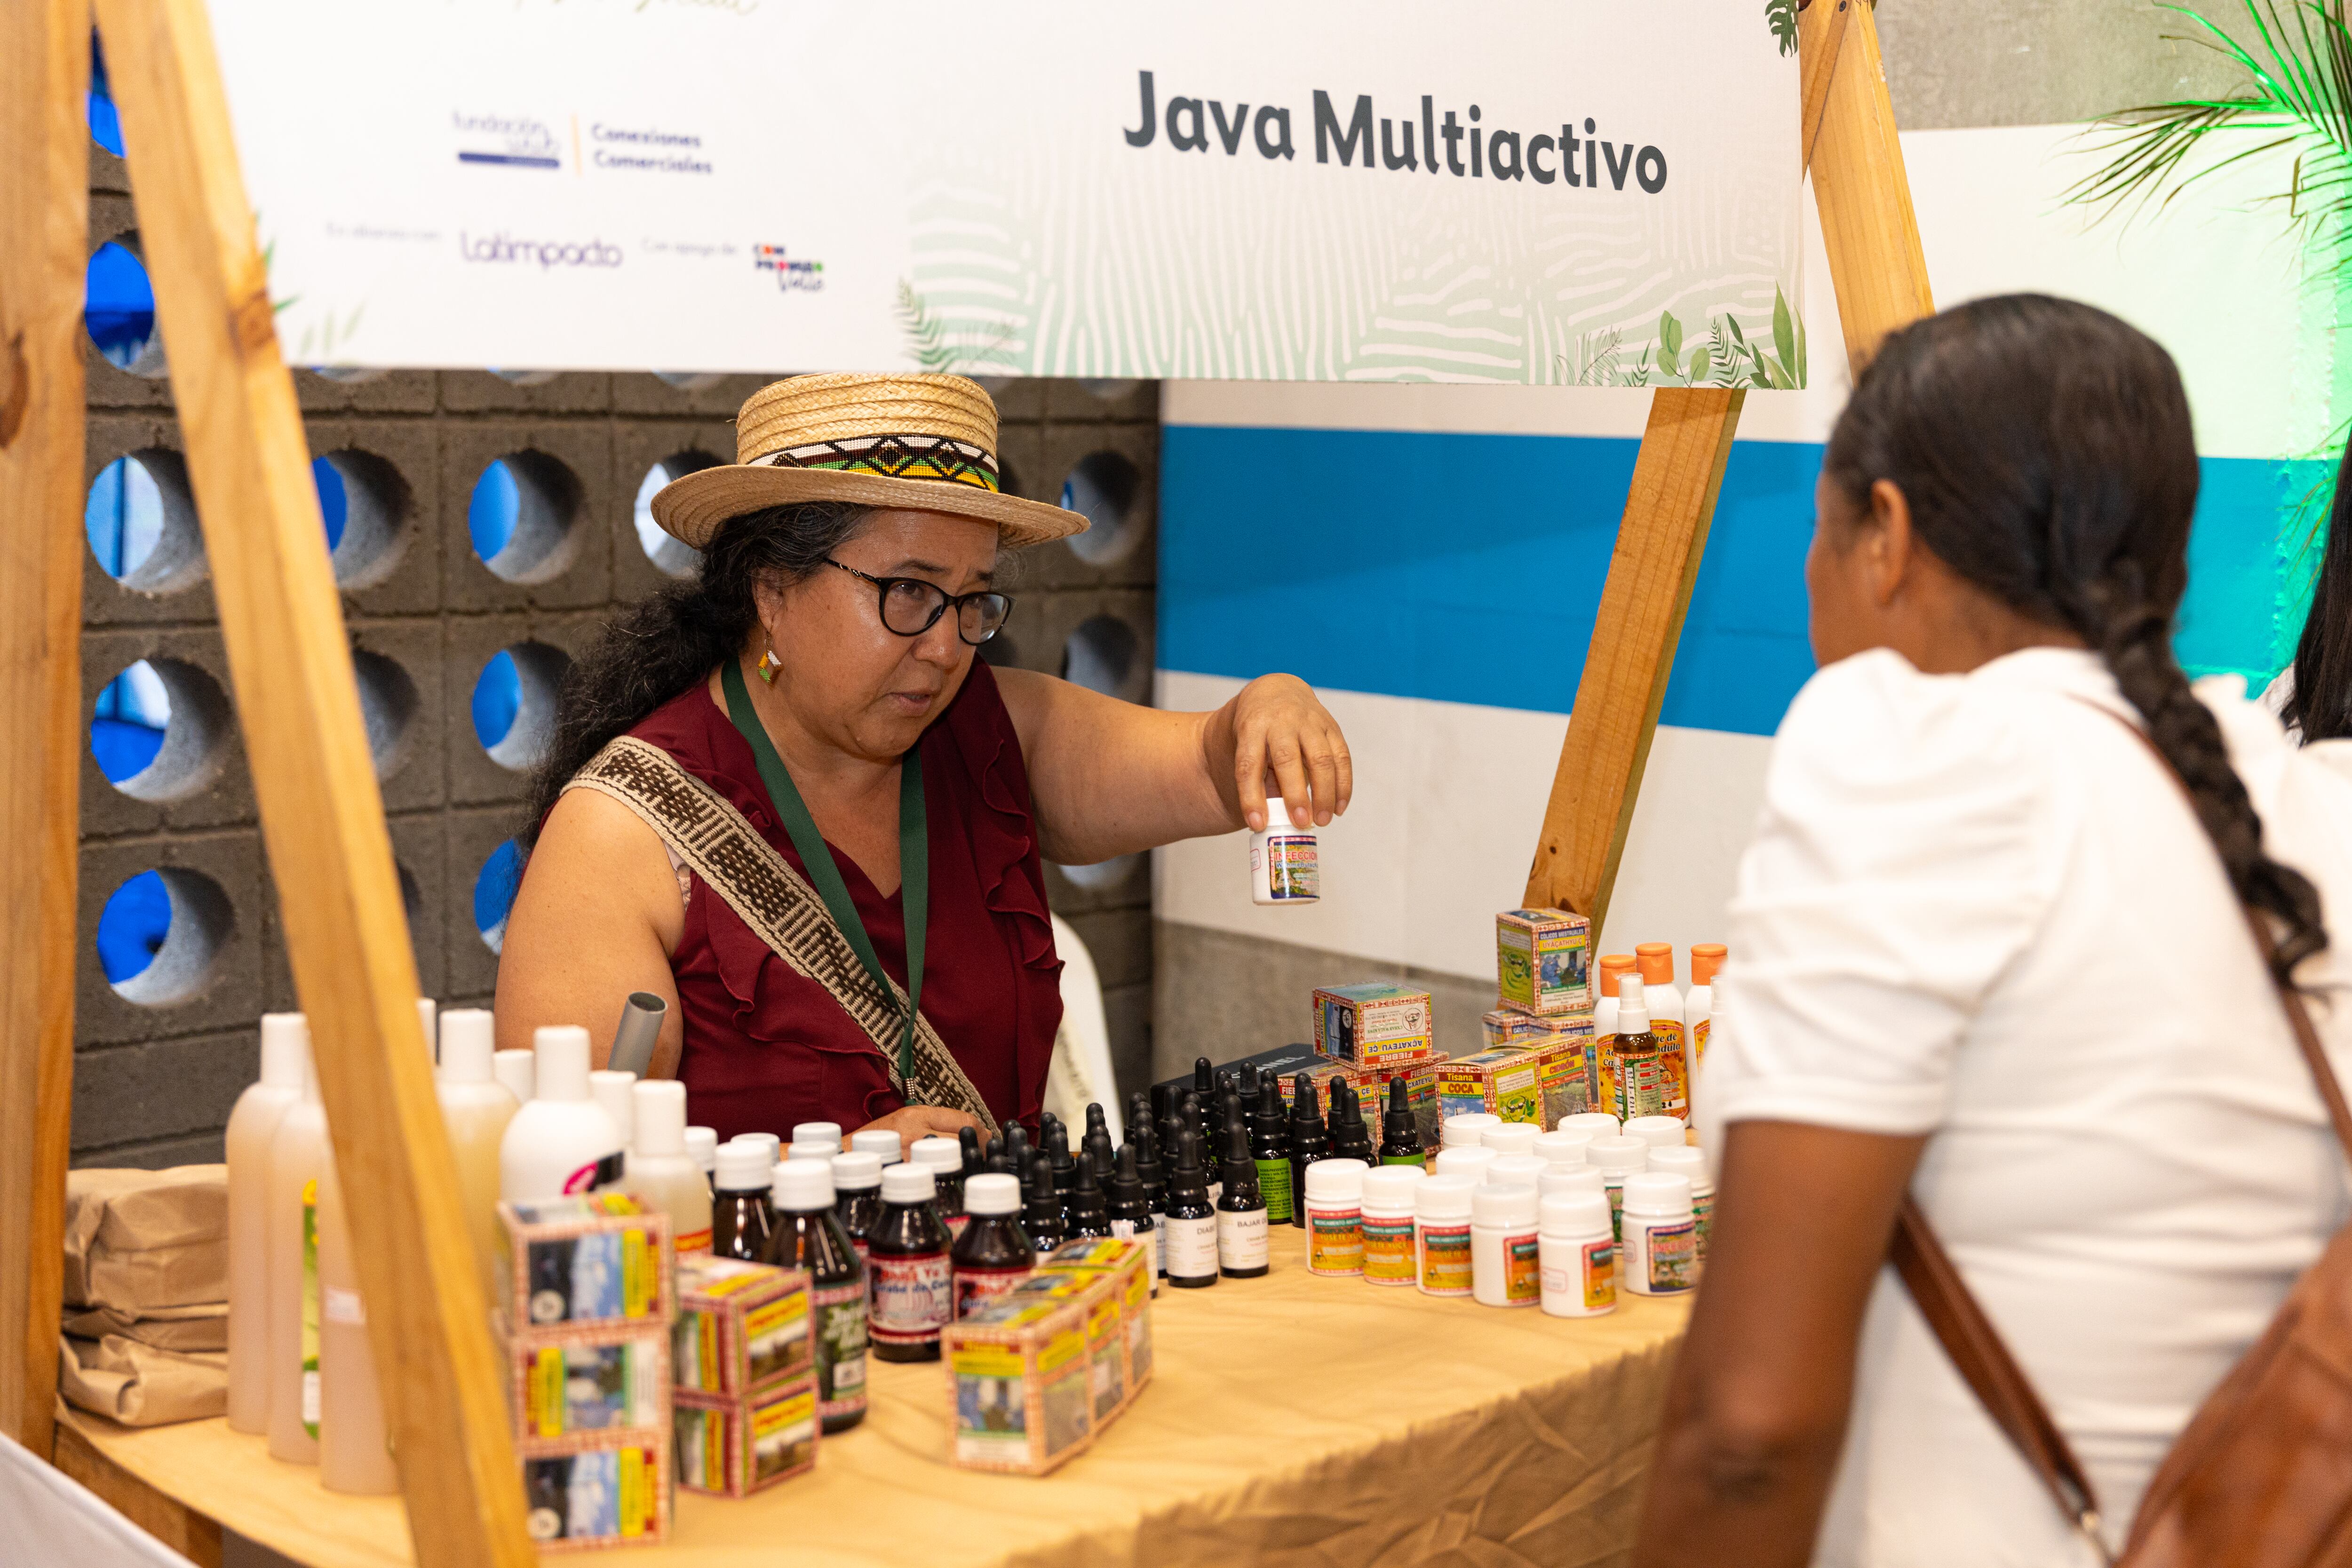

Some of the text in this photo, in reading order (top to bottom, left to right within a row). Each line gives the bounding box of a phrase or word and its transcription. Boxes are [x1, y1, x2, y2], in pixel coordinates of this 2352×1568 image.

[591, 123, 701, 148] Conexiones
[1124, 69, 1668, 194] Java Multiactivo
[594, 148, 712, 174] Comerciales
[460, 228, 624, 272] Latimpacto
[1540, 930, 1558, 940] CÓLICOS
[1513, 1026, 1528, 1034] CÓLIC
[1667, 1033, 1677, 1042] de
[1379, 1051, 1414, 1062] FIEBRE
[1550, 1051, 1571, 1062] Tisana
[1410, 1066, 1435, 1079] FIEBRE
[1447, 1073, 1474, 1082] Tisana
[1407, 1075, 1433, 1090] ÇXATEYU
[1448, 1083, 1474, 1094] COCA
[1238, 1219, 1260, 1228] BAJAR
